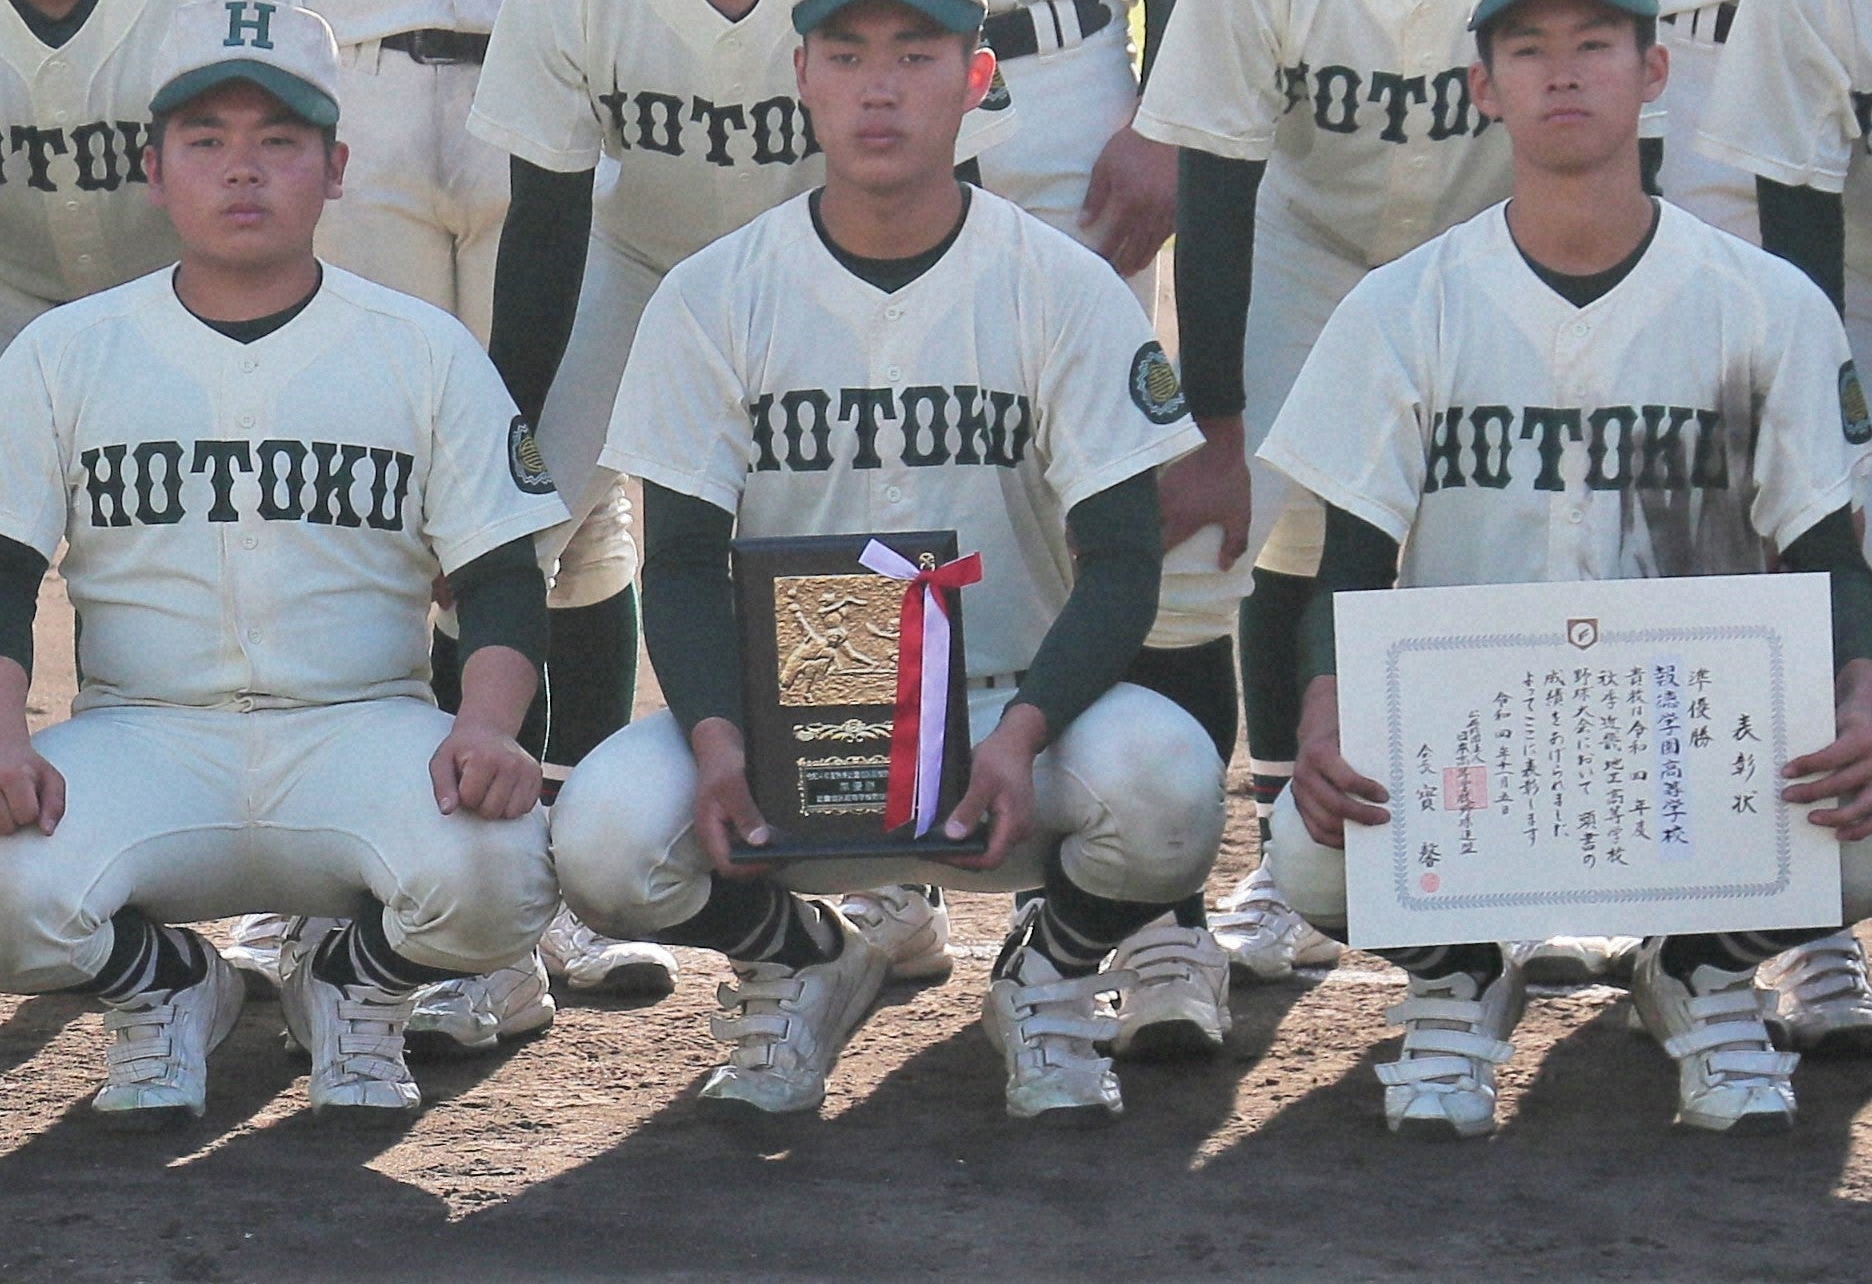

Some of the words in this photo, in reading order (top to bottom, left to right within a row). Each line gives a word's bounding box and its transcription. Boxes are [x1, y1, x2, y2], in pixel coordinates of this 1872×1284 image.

[223, 2, 276, 50] H
[80, 440, 414, 531] HOTOKU
[1423, 405, 1729, 493] HOTOKU
